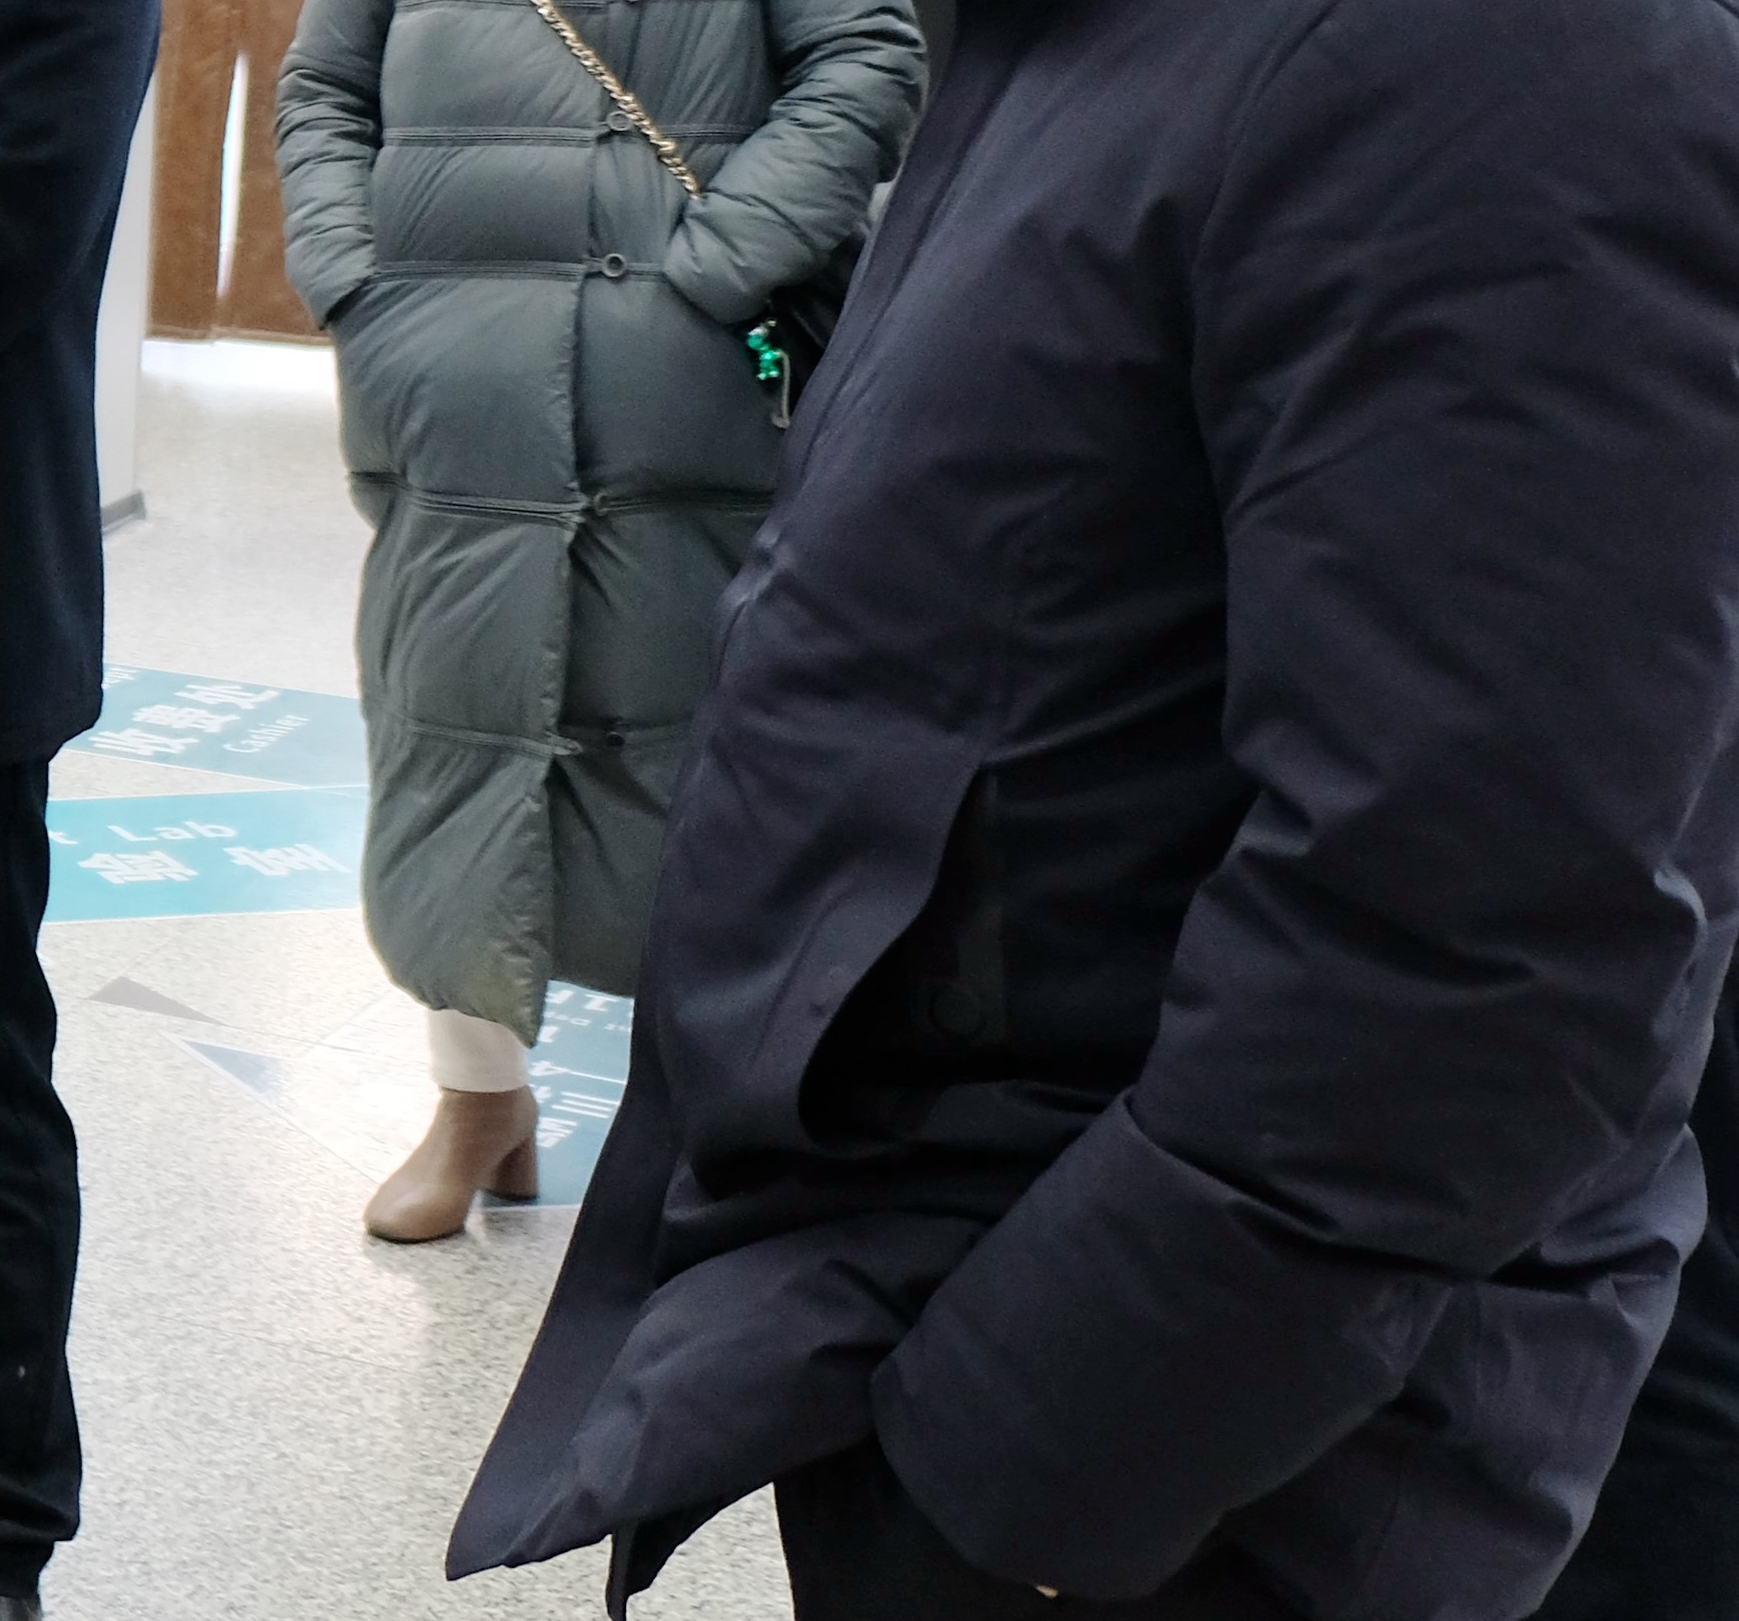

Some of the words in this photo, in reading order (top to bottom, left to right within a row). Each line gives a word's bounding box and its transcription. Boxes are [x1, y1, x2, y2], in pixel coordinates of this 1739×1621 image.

[87, 684, 282, 756] 收费处
[221, 714, 311, 754] Cashier
[106, 820, 238, 842] Lab
